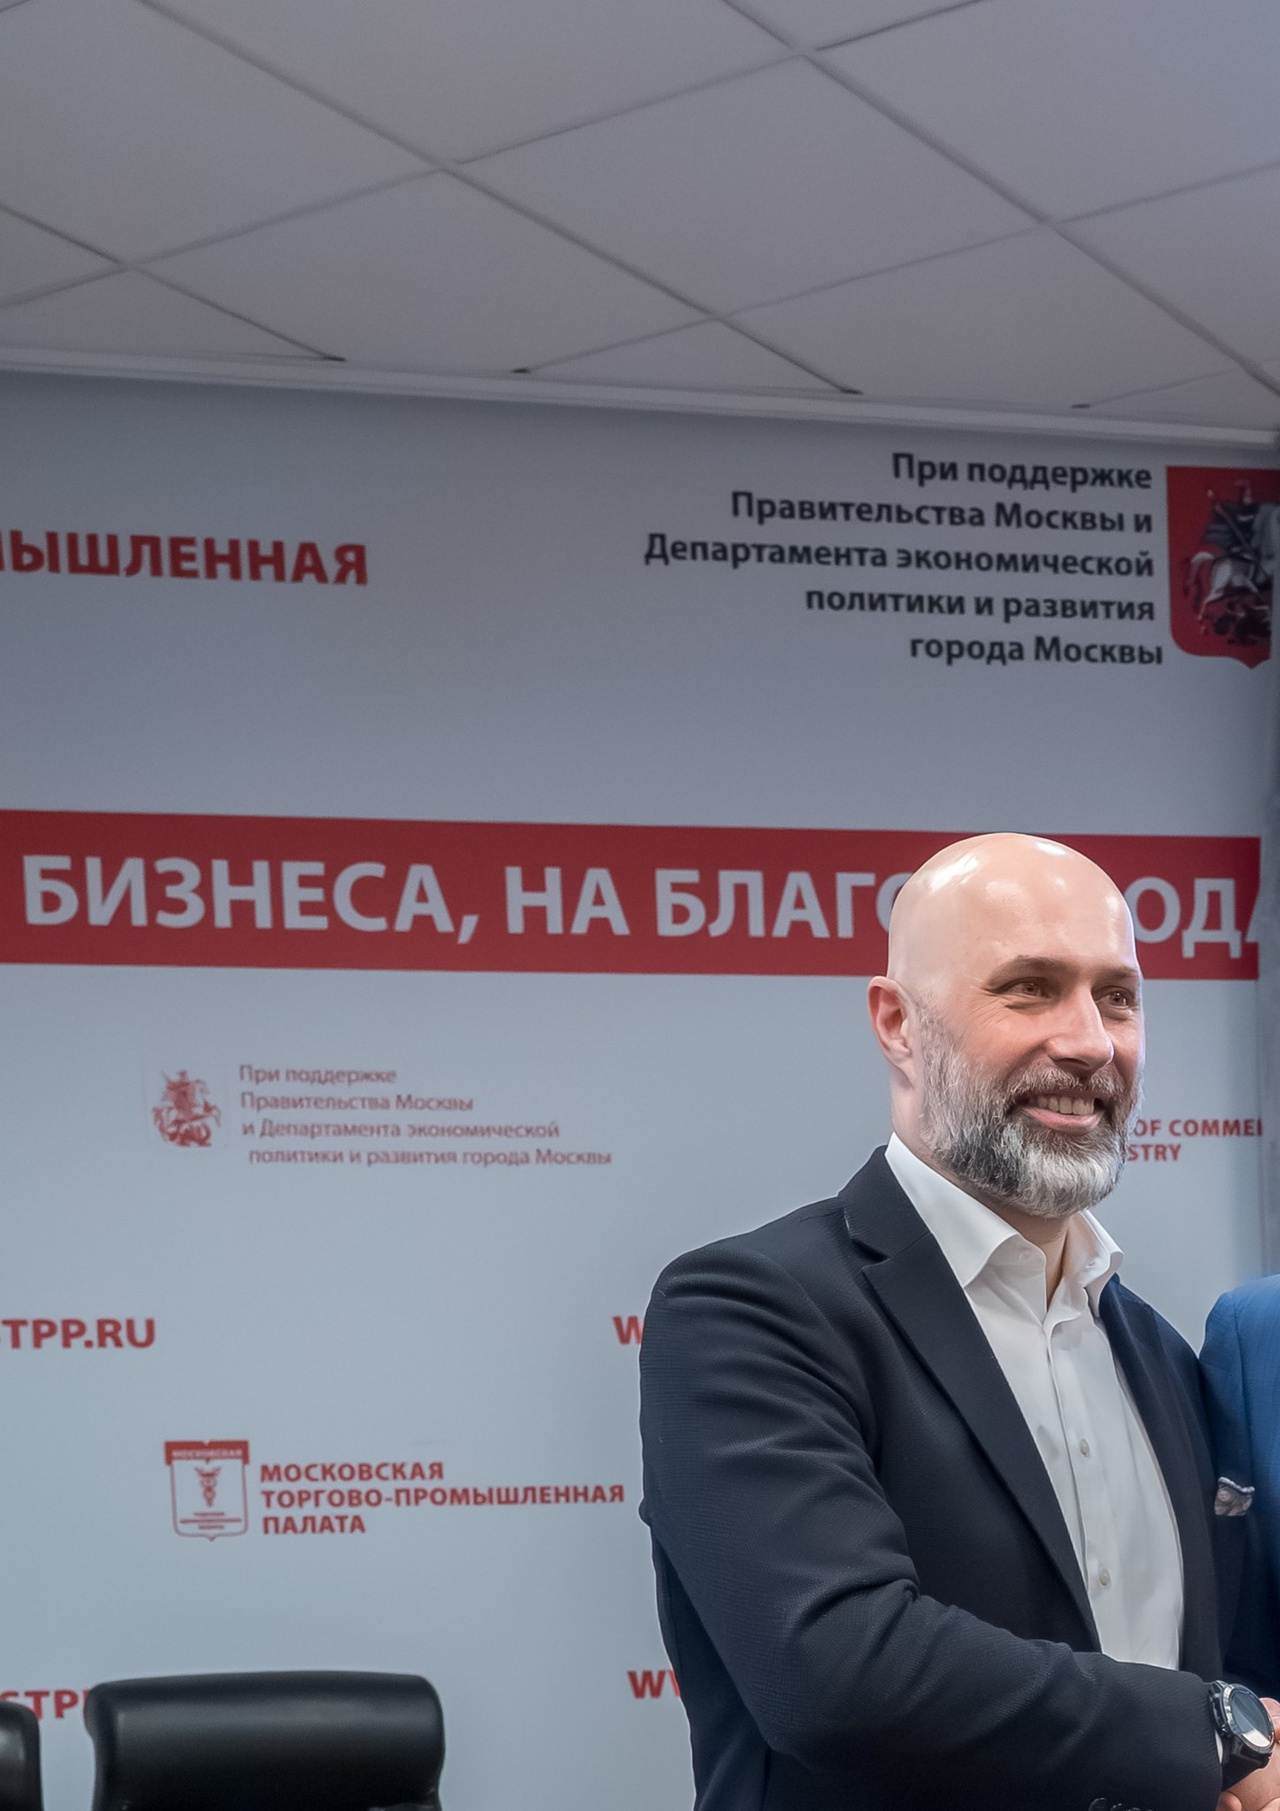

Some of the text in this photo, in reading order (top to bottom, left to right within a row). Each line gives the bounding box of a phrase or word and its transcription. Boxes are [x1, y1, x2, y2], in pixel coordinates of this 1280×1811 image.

[891, 452, 1153, 494] При поддержке
[731, 490, 1153, 534] Правительства Москвы и
[0, 529, 368, 586] ЫШЛЕННАЯ
[643, 532, 1154, 578] Департамента экономической
[805, 590, 1155, 624] политики и развития
[910, 635, 1163, 667] города Москвы
[23, 855, 479, 944] БИЗНЕСА,
[504, 865, 630, 936] НА
[239, 1063, 397, 1087] При поддержке
[239, 1090, 474, 1114] Правительства Москвы
[241, 1117, 560, 1140] и Департамента экономической
[248, 1147, 613, 1169] политики и развития города Москвы
[1126, 1143, 1182, 1162] STRY
[0, 1318, 156, 1350] TPP.RU
[260, 1461, 444, 1483] МОСКОВСКАЯ
[260, 1484, 625, 1509] ТОРГОВО-ПРОМЫШЛЕННАЯ
[262, 1514, 366, 1535] ПАЛАТА
